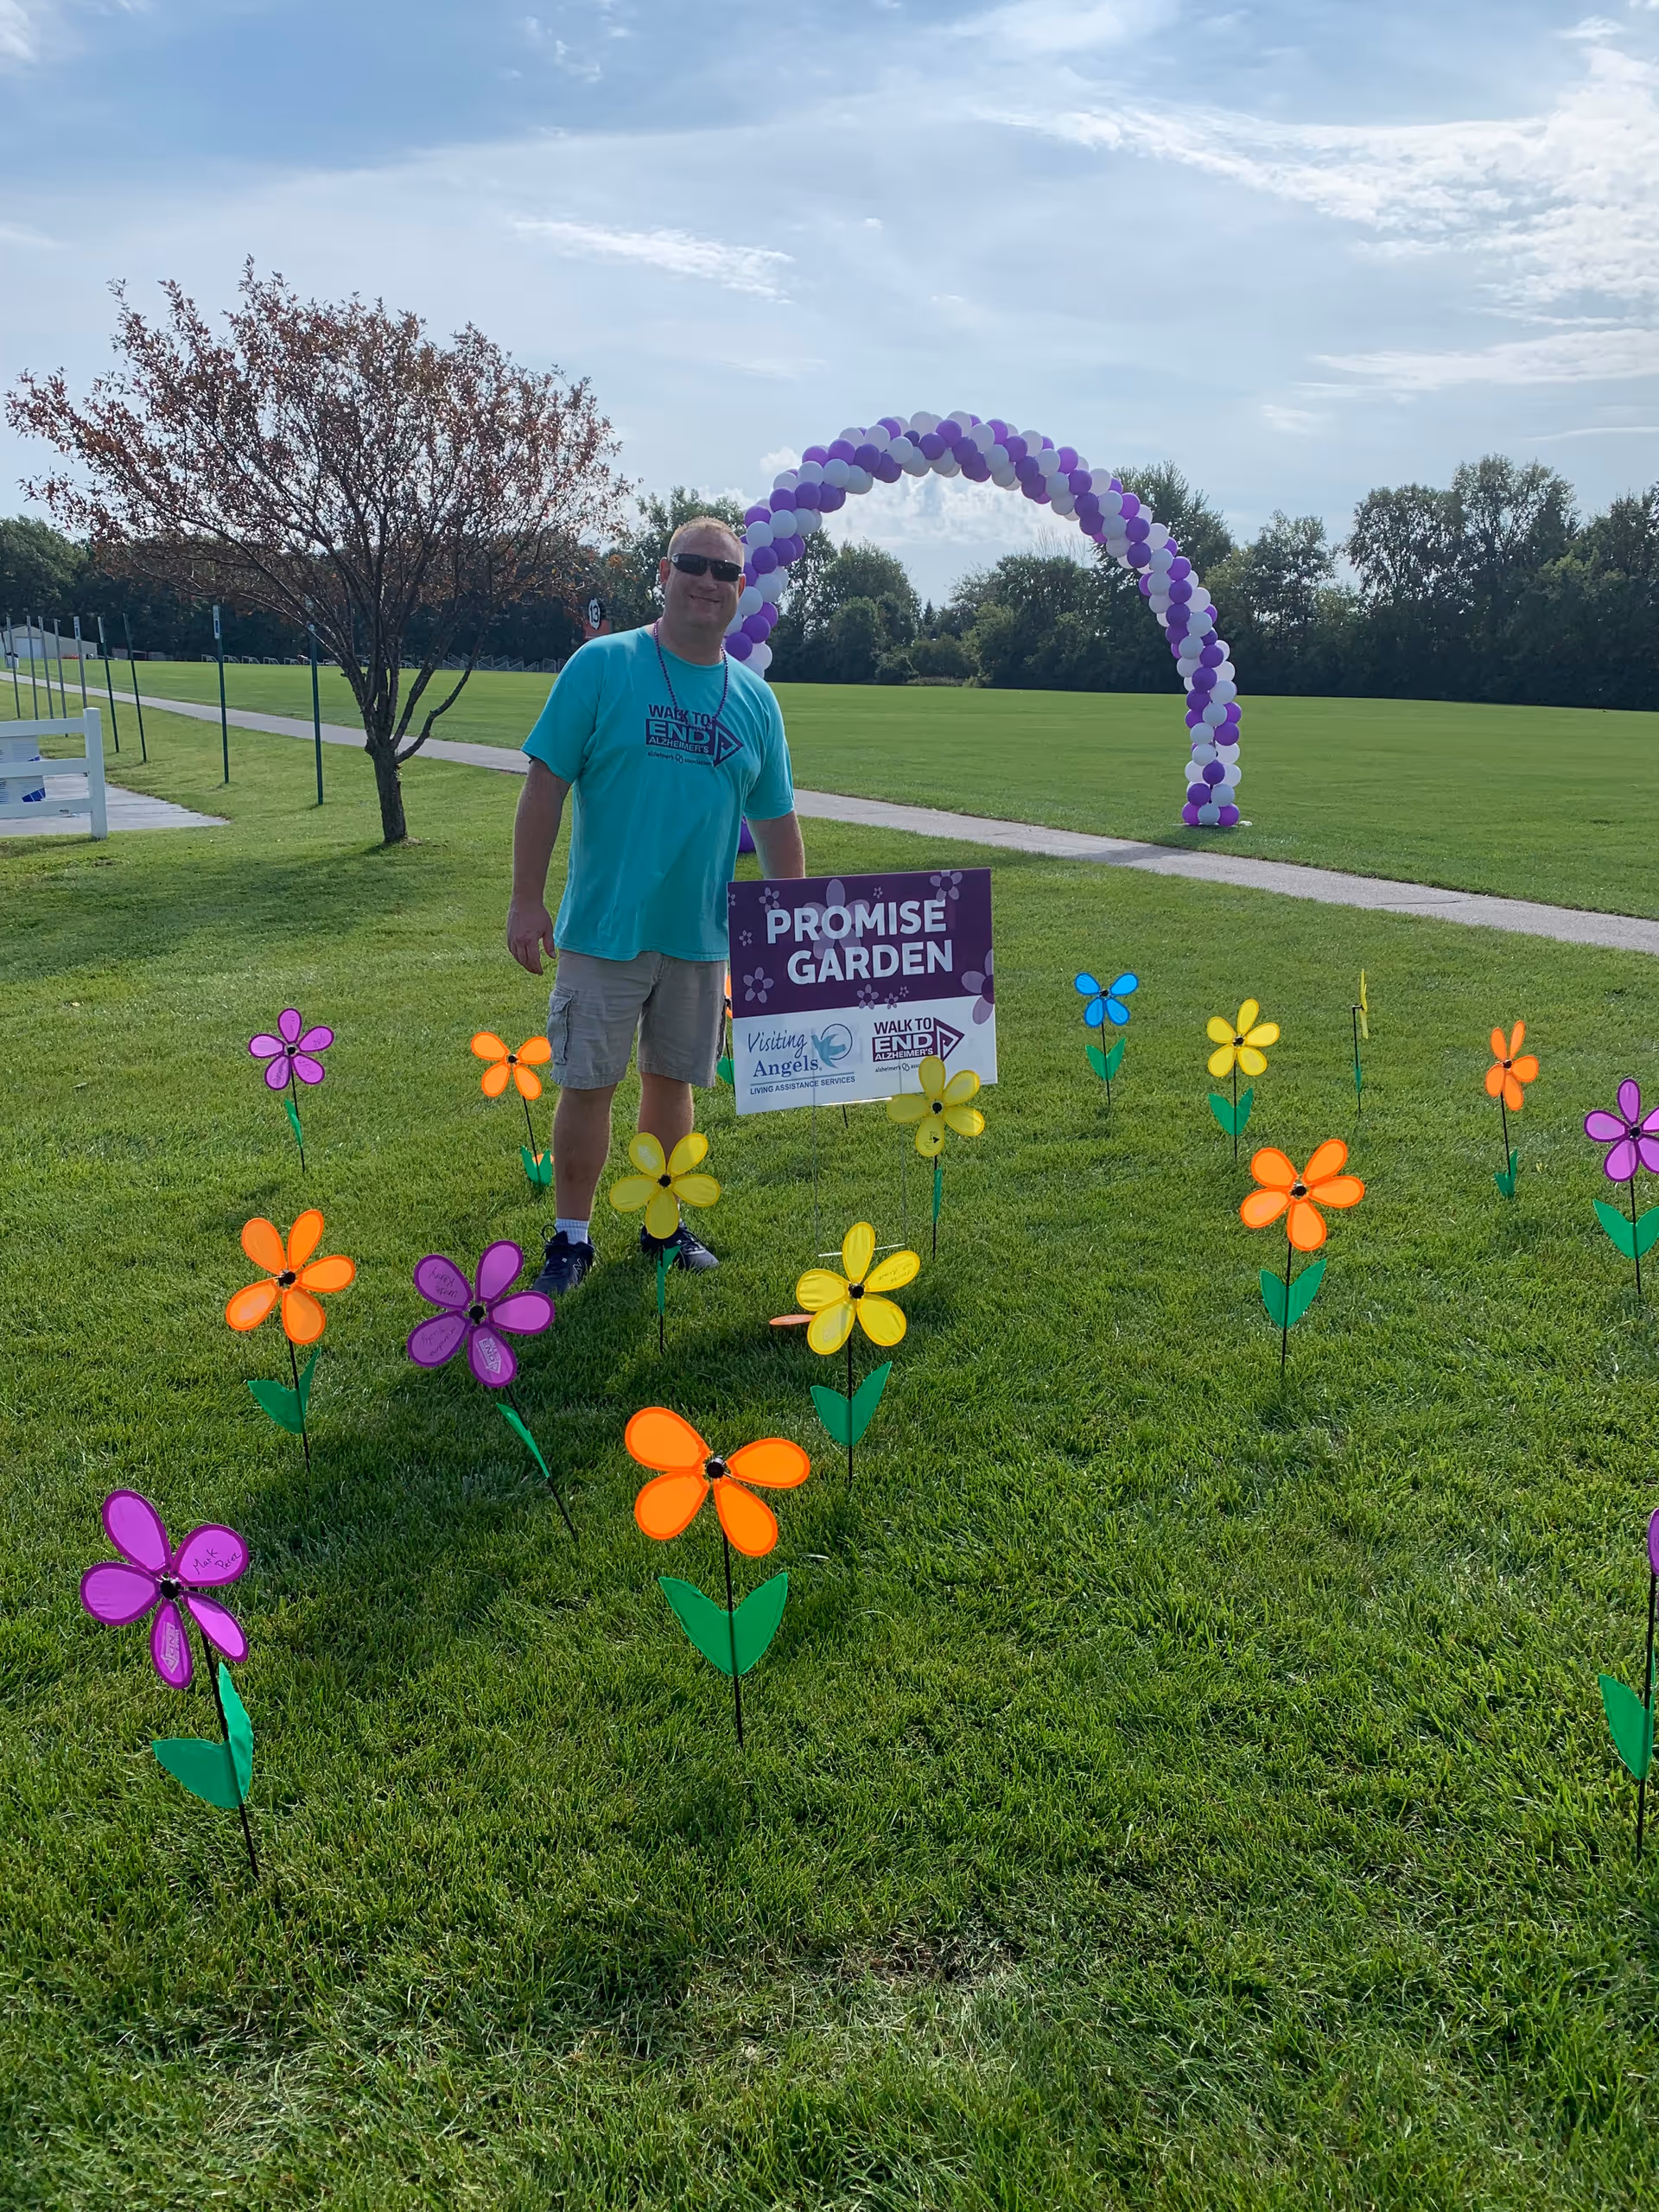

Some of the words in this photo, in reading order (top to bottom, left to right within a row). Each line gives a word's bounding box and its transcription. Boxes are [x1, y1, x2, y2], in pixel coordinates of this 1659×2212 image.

[590, 605, 600, 622] 13
[648, 703, 689, 723] WALK
[692, 711, 711, 727] TO
[649, 720, 710, 744] END
[648, 736, 709, 753] ALZHEIMER'S
[766, 899, 947, 944] PROMISE
[787, 939, 953, 985] GARDEN
[874, 1019, 912, 1035] WALK
[915, 1017, 931, 1030] TO
[747, 1030, 808, 1059] Visiting
[874, 1033, 933, 1052] END
[874, 1048, 933, 1061] ALZHEIMER'S
[750, 1085, 773, 1095] LIVING
[775, 1080, 819, 1092] ASSISTANCE
[821, 1076, 855, 1086] SERVICES
[193, 1548, 218, 1575] Mark
